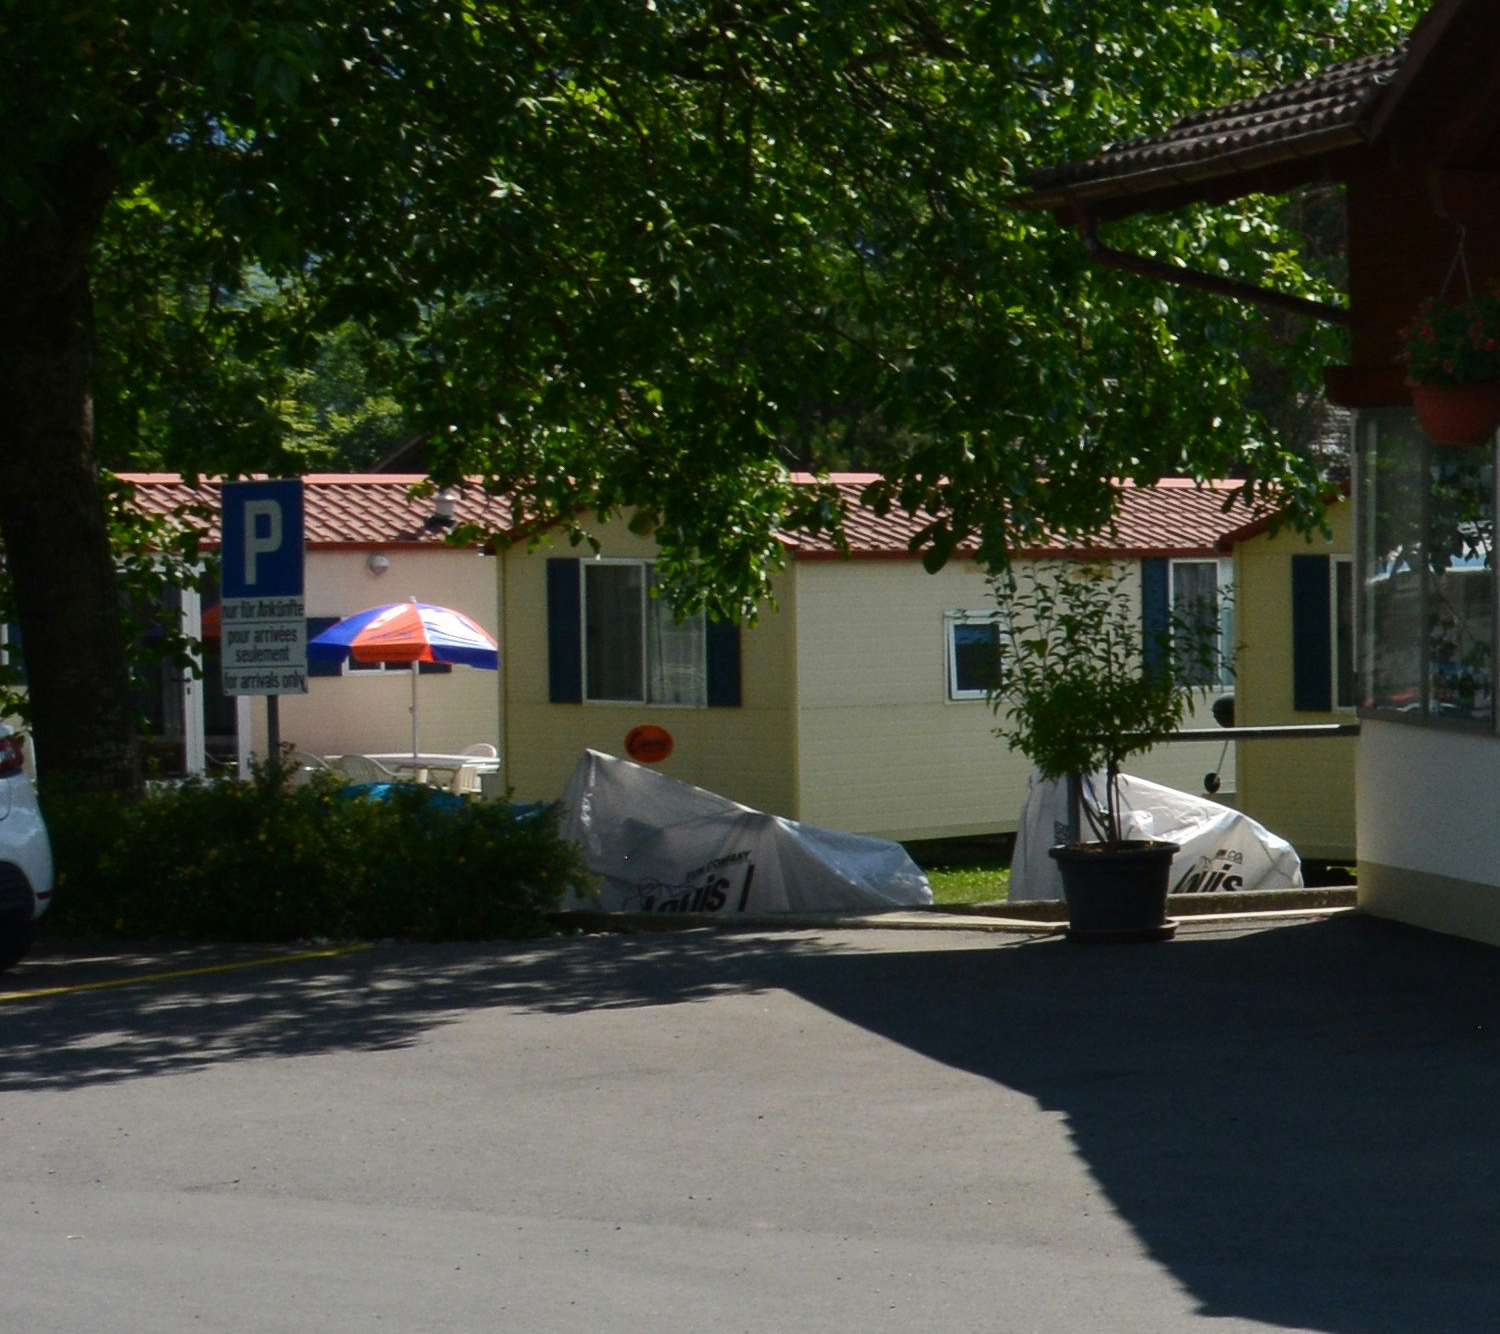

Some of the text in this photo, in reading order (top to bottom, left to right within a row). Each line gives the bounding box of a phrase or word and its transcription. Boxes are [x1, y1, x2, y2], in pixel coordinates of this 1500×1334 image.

[244, 500, 282, 585] P
[228, 625, 297, 647] pour arrivées
[235, 644, 290, 662] seulement
[224, 668, 307, 693] for arrivals only
